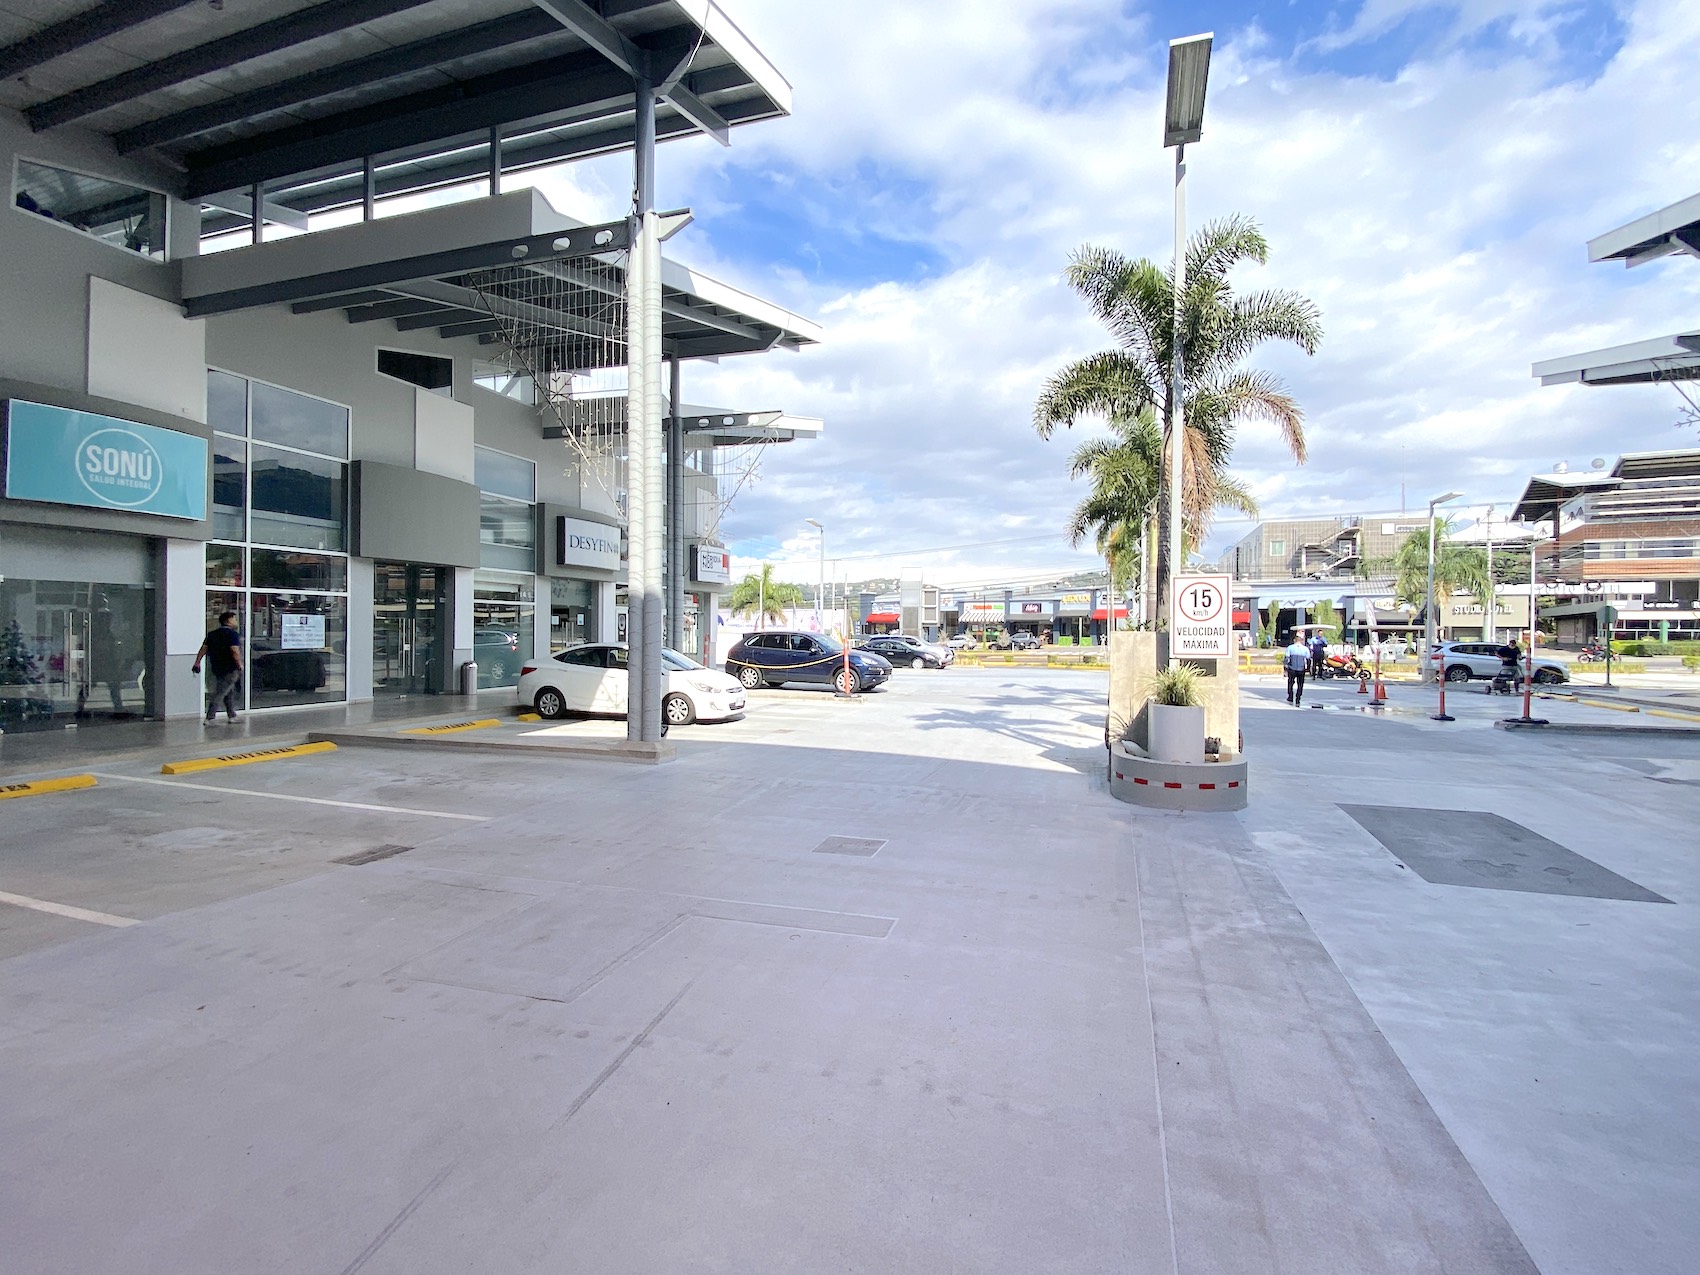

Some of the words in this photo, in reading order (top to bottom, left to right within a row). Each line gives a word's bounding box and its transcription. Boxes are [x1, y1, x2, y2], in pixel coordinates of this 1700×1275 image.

[86, 444, 152, 481] SONÚ
[89, 473, 115, 485] SALUD
[117, 477, 152, 490] INTEGRAL
[569, 534, 613, 553] DESYFIN
[1190, 589, 1212, 608] 15
[1176, 626, 1225, 636] VELOCIDAD
[1182, 638, 1219, 649] MÁXIMA
